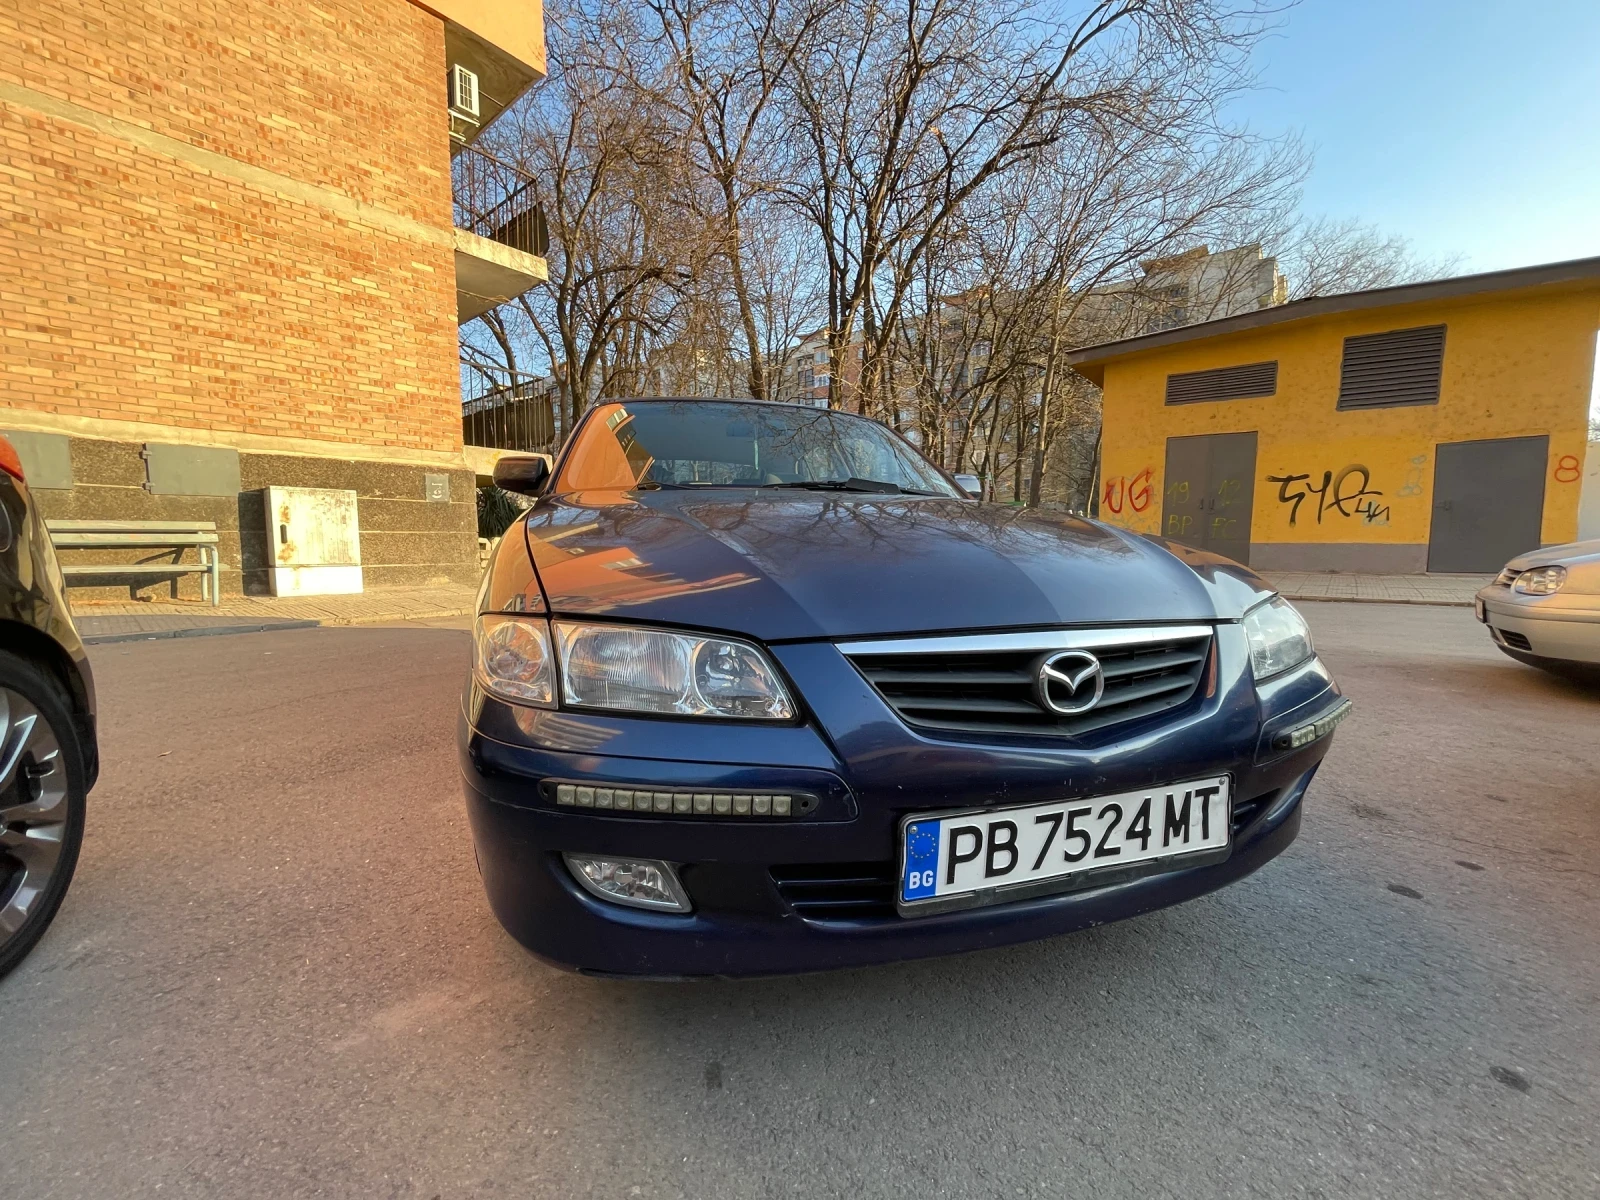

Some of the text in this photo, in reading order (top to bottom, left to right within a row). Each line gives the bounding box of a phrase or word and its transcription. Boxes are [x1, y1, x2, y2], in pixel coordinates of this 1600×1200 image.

[1554, 455, 1581, 483] 8
[946, 786, 1220, 885] PB 7524 MT
[908, 869, 934, 889] BG
